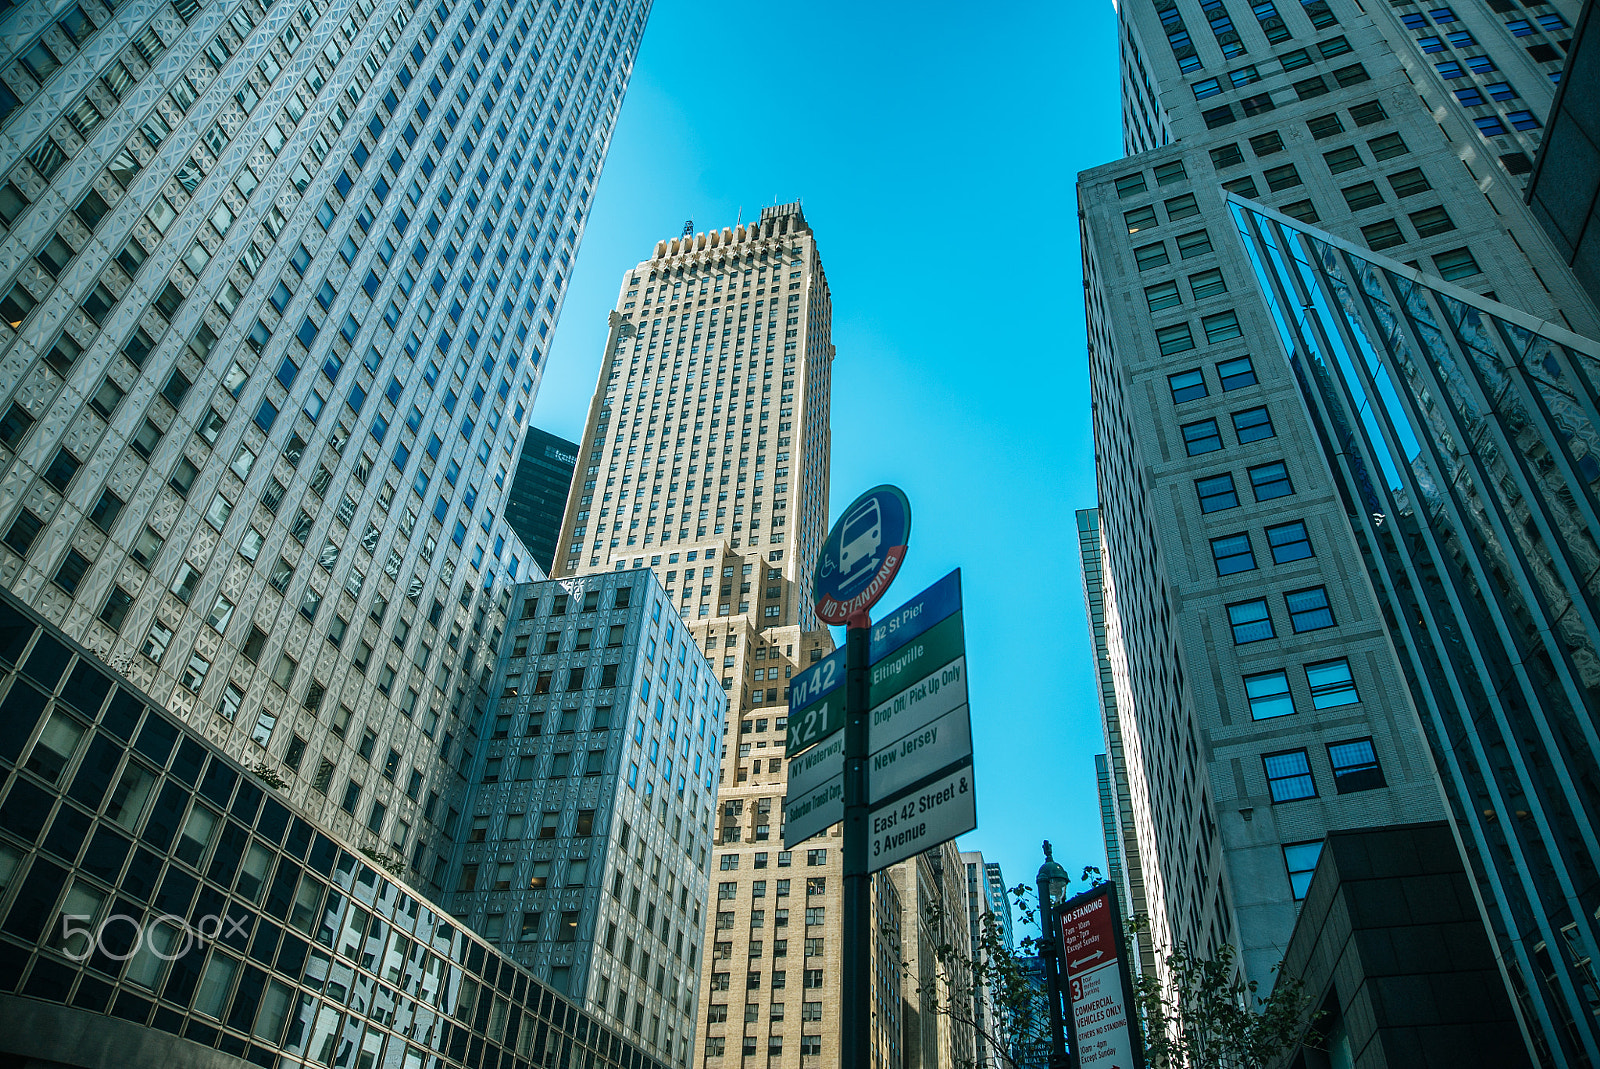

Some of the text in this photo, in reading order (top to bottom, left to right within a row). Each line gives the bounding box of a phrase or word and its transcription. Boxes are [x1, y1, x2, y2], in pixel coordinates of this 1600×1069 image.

[822, 599, 838, 618] NO
[839, 556, 897, 617] STANDING
[874, 602, 924, 642] 42 St Pier
[873, 645, 924, 685] Eltingville
[792, 659, 836, 709] M42
[874, 706, 892, 726] Drop
[910, 684, 927, 705] Pick
[928, 678, 940, 694] Up
[942, 666, 960, 686] Only
[789, 702, 828, 750] X21
[792, 738, 842, 778] NY Waterway
[874, 727, 938, 772] New Jersey
[790, 800, 811, 823] Suburban
[812, 789, 828, 810] Transit
[874, 776, 968, 834] East 42 Street &
[874, 822, 926, 857] 3 Avenue
[1063, 899, 1102, 924] NO STANDING
[1066, 928, 1075, 936] 7am
[1067, 936, 1076, 944] 4pm
[1067, 934, 1100, 954] Except Sunday
[1072, 980, 1082, 1000] 3
[1075, 995, 1114, 1017] COMMERCIAL
[1076, 1004, 1122, 1028] VEHICLES ONLY
[1078, 1019, 1126, 1041] OTHERS NO STANDING
[1080, 1046, 1092, 1055] 10am
[1097, 1040, 1107, 1050] 4pm
[1081, 1048, 1116, 1064] Except Sunday
